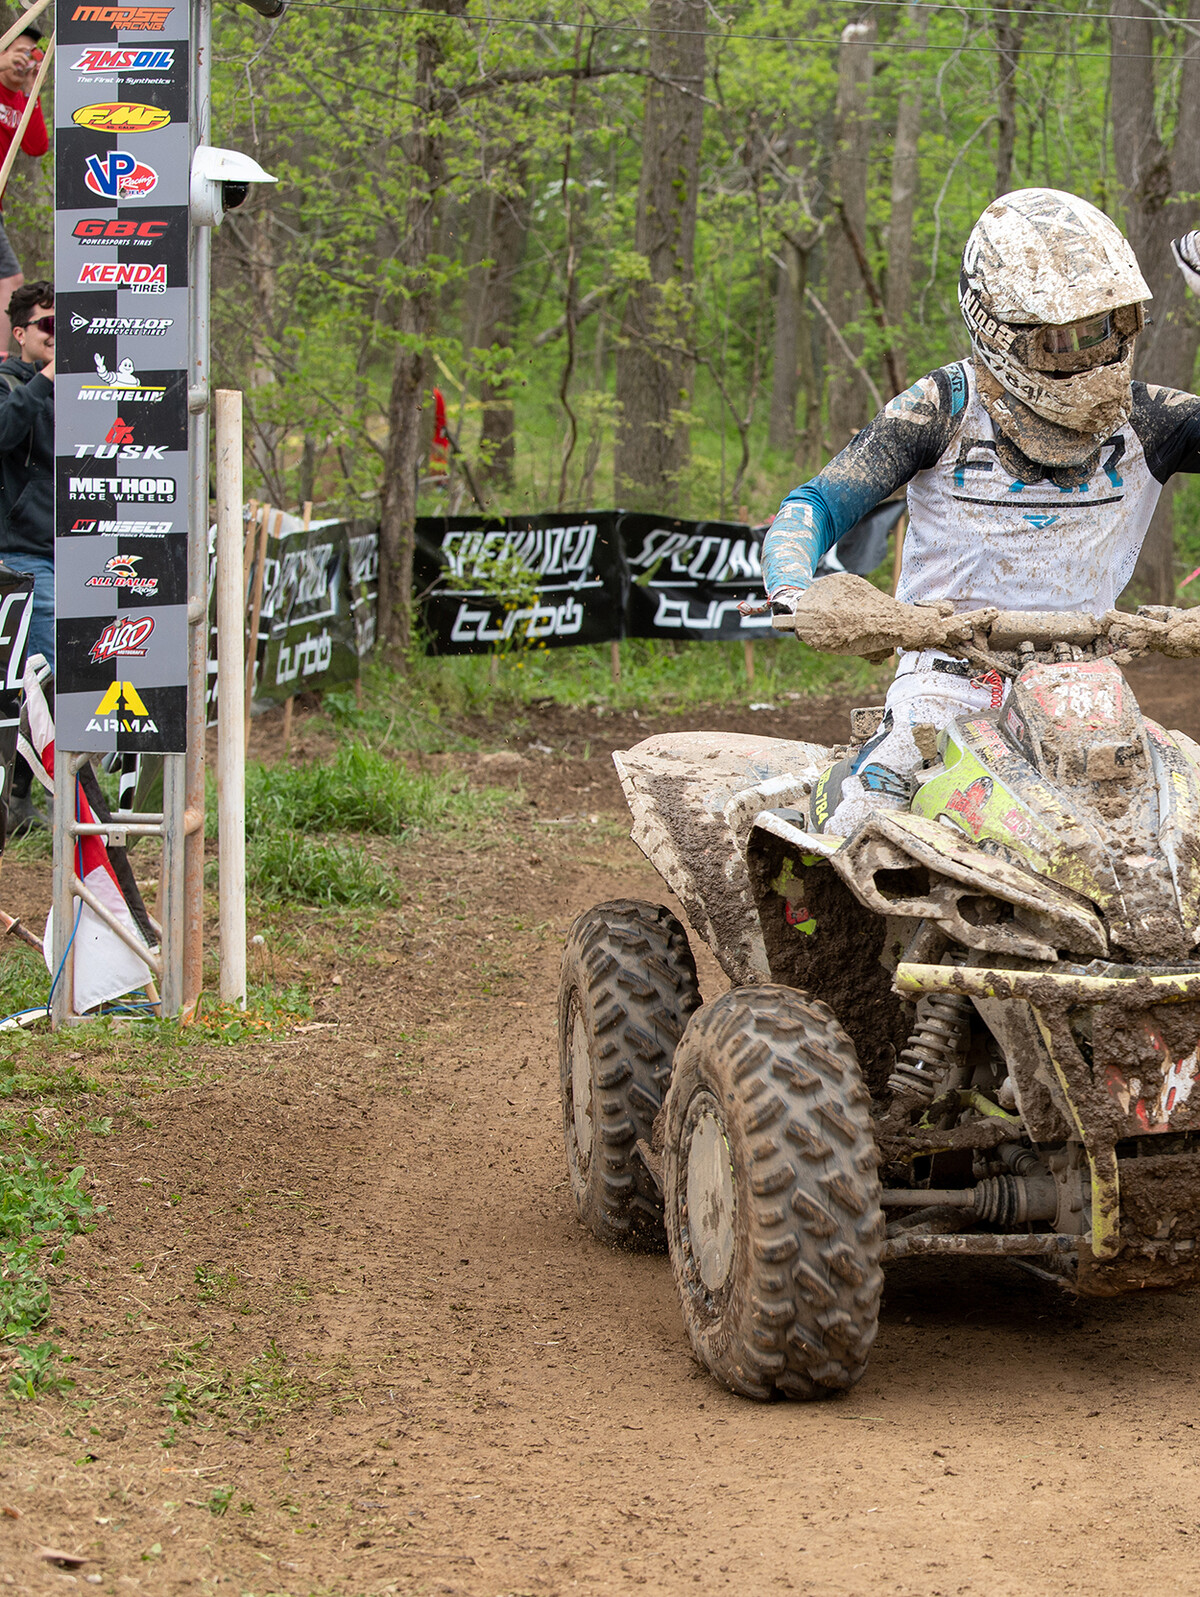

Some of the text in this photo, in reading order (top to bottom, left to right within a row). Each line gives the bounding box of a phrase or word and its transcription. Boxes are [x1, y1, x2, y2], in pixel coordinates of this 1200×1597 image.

[71, 5, 175, 22] MOOSE
[110, 21, 165, 31] RACING
[76, 50, 172, 72] AMSOIL
[75, 106, 170, 125] FMF
[88, 153, 136, 196] VP
[120, 175, 159, 189] Racing
[73, 220, 168, 237] GBC
[80, 264, 166, 283] KENDA
[132, 284, 165, 293] TIRES
[89, 318, 173, 329] DUNLOP
[77, 390, 164, 402] MICHELIN
[74, 444, 169, 460] TUSK
[69, 477, 175, 494] METHOD
[114, 494, 175, 502] WHEELS
[85, 577, 158, 588] ALL BALLS
[451, 597, 584, 642] turbo
[85, 719, 159, 733] ARMA
